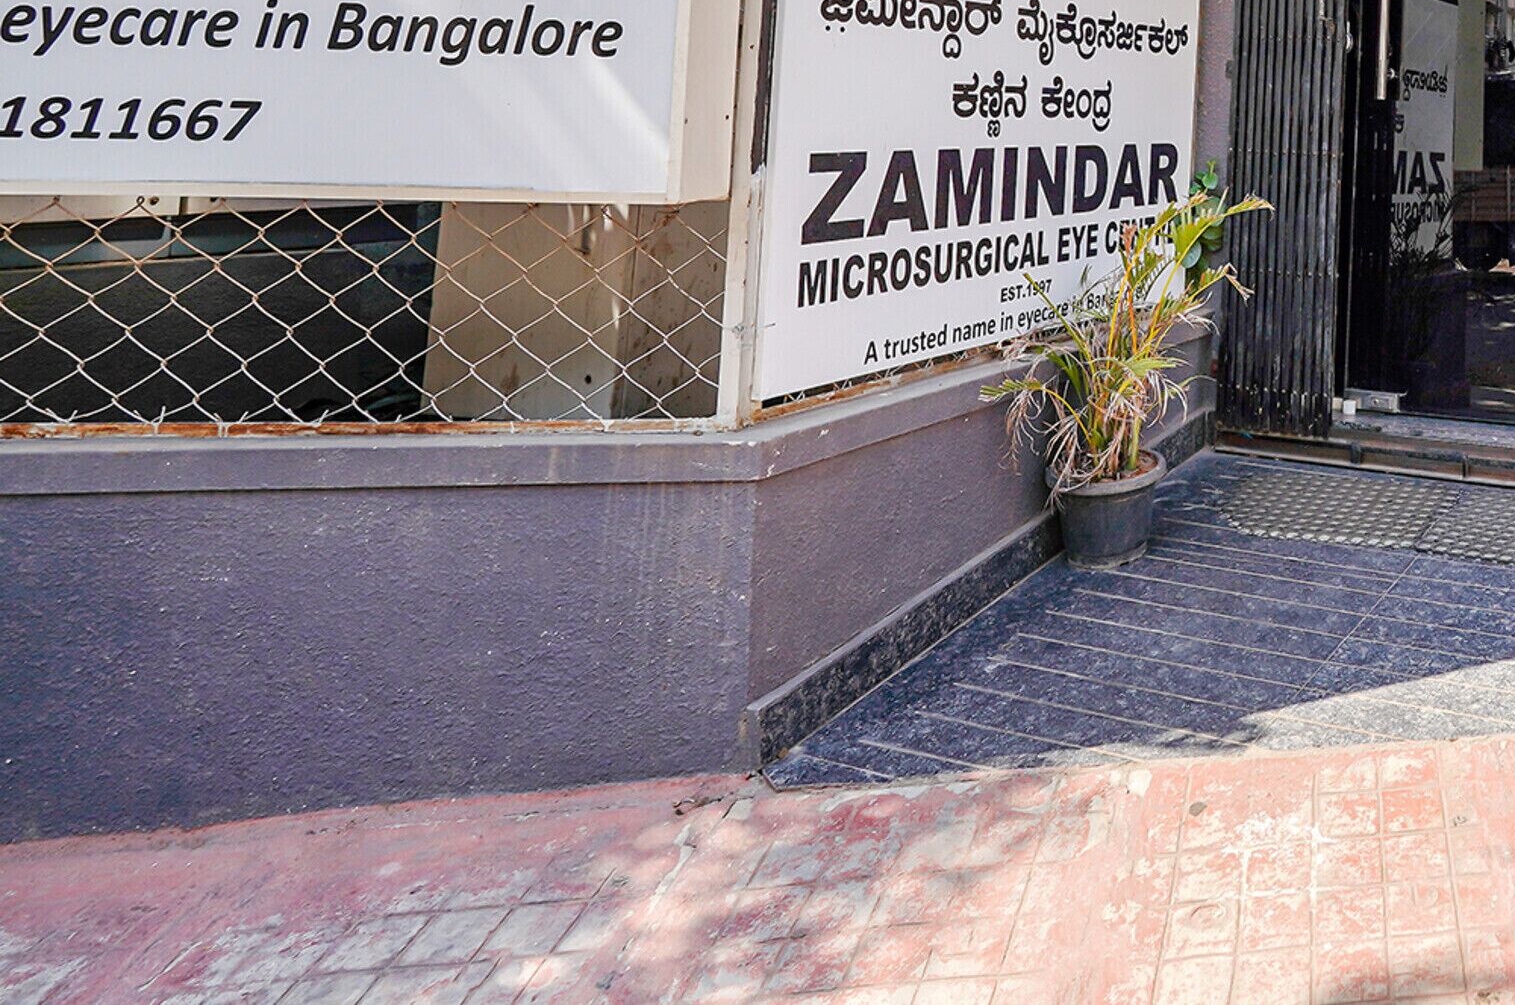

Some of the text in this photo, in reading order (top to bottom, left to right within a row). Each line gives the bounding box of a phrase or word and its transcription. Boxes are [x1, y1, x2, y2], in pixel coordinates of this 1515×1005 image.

[0, 2, 240, 57] eyecare
[326, 2, 625, 67] Bangalore
[0, 95, 262, 142] 1811667
[800, 142, 1179, 246] ZAMINDAR
[796, 231, 1050, 308] MICROSURGICAL
[1056, 223, 1100, 263] EYE
[863, 340, 878, 366] A
[884, 323, 948, 359] trusted
[952, 319, 997, 344] name
[1000, 311, 1013, 332] in
[1017, 302, 1069, 330] eyecare
